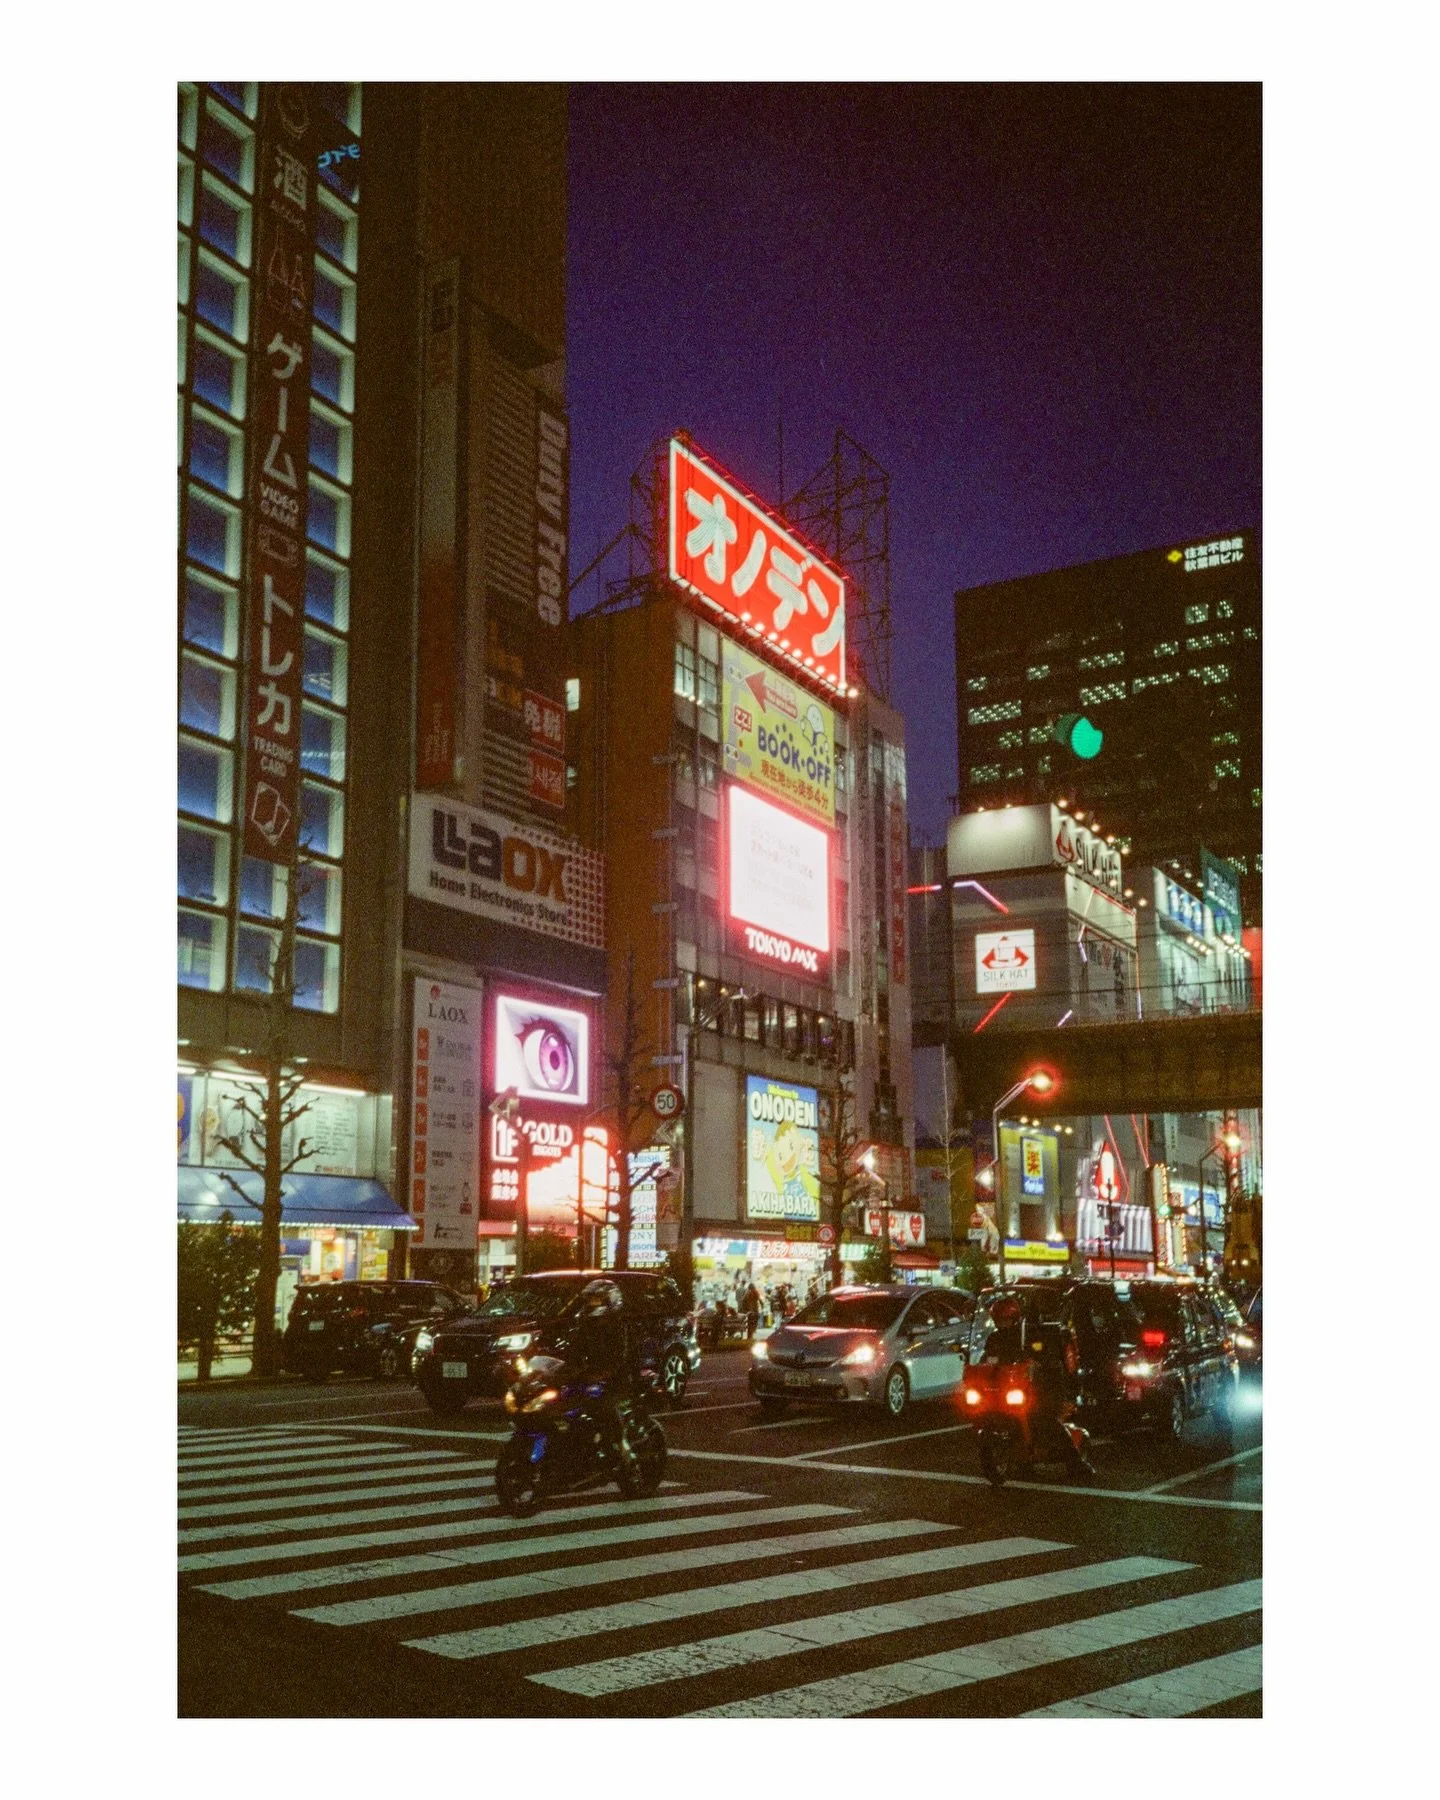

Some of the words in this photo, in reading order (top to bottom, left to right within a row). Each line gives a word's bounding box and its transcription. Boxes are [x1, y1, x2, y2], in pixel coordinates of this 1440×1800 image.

[263, 331, 301, 491] ゲーム
[537, 411, 567, 519] Duty
[259, 481, 299, 514] VIDEO
[537, 521, 565, 627] Free
[684, 488, 845, 657] オノデン
[256, 574, 295, 737] トレカ
[253, 735, 294, 765] TRADING
[260, 755, 288, 778] CARD
[430, 870, 466, 897] Home
[470, 881, 535, 917] Electronics
[536, 902, 568, 926] Store
[745, 927, 791, 962] TOKYO
[983, 970, 1006, 982] SILK
[1009, 969, 1029, 979] HAT
[428, 1003, 469, 1025] LAOX
[656, 1095, 675, 1110] 50
[751, 1090, 815, 1127] ONODEN
[522, 1120, 573, 1149] GOLD
[751, 1190, 817, 1217] AKIHABARA
